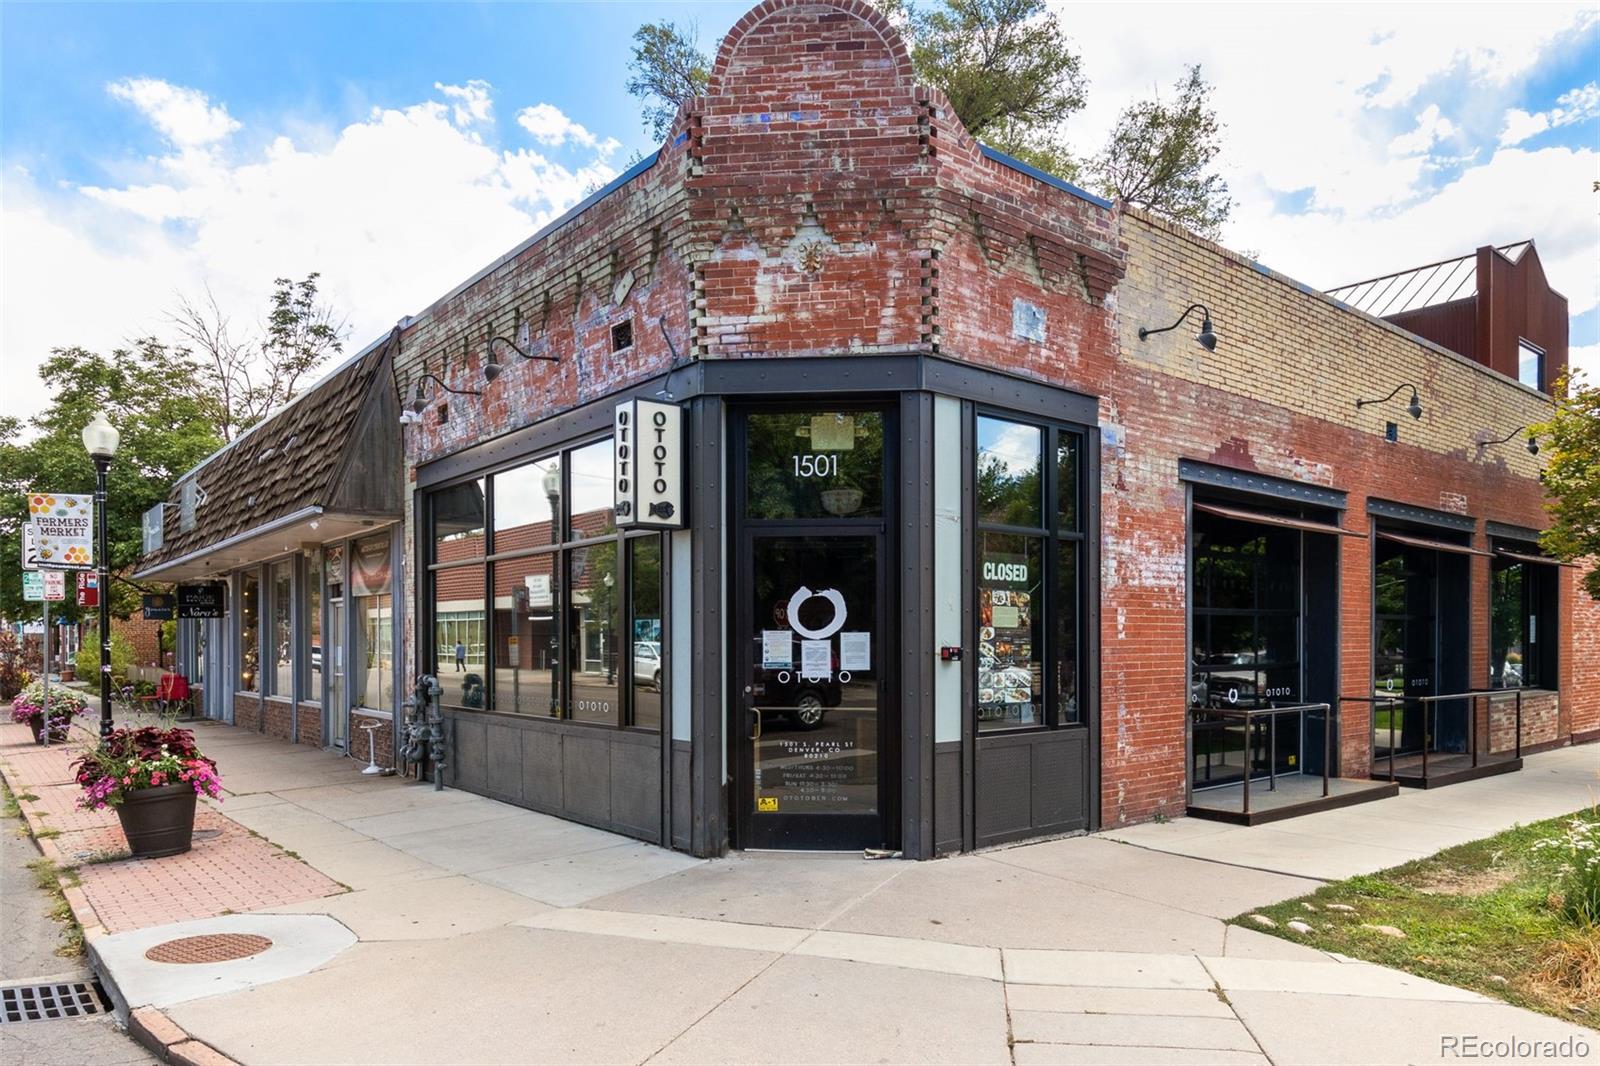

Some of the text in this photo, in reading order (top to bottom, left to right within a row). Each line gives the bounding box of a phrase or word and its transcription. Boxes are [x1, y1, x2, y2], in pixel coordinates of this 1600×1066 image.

[618, 411, 628, 493] OTOTO
[653, 411, 667, 494] OTOTO
[792, 454, 837, 477] 1501
[36, 517, 89, 527] FARMERS
[40, 527, 86, 537] MARKET
[983, 562, 1028, 582] CLOSED
[182, 607, 219, 617] Nora's
[1266, 687, 1291, 697] OTOTO
[579, 701, 609, 713] OTOTO
